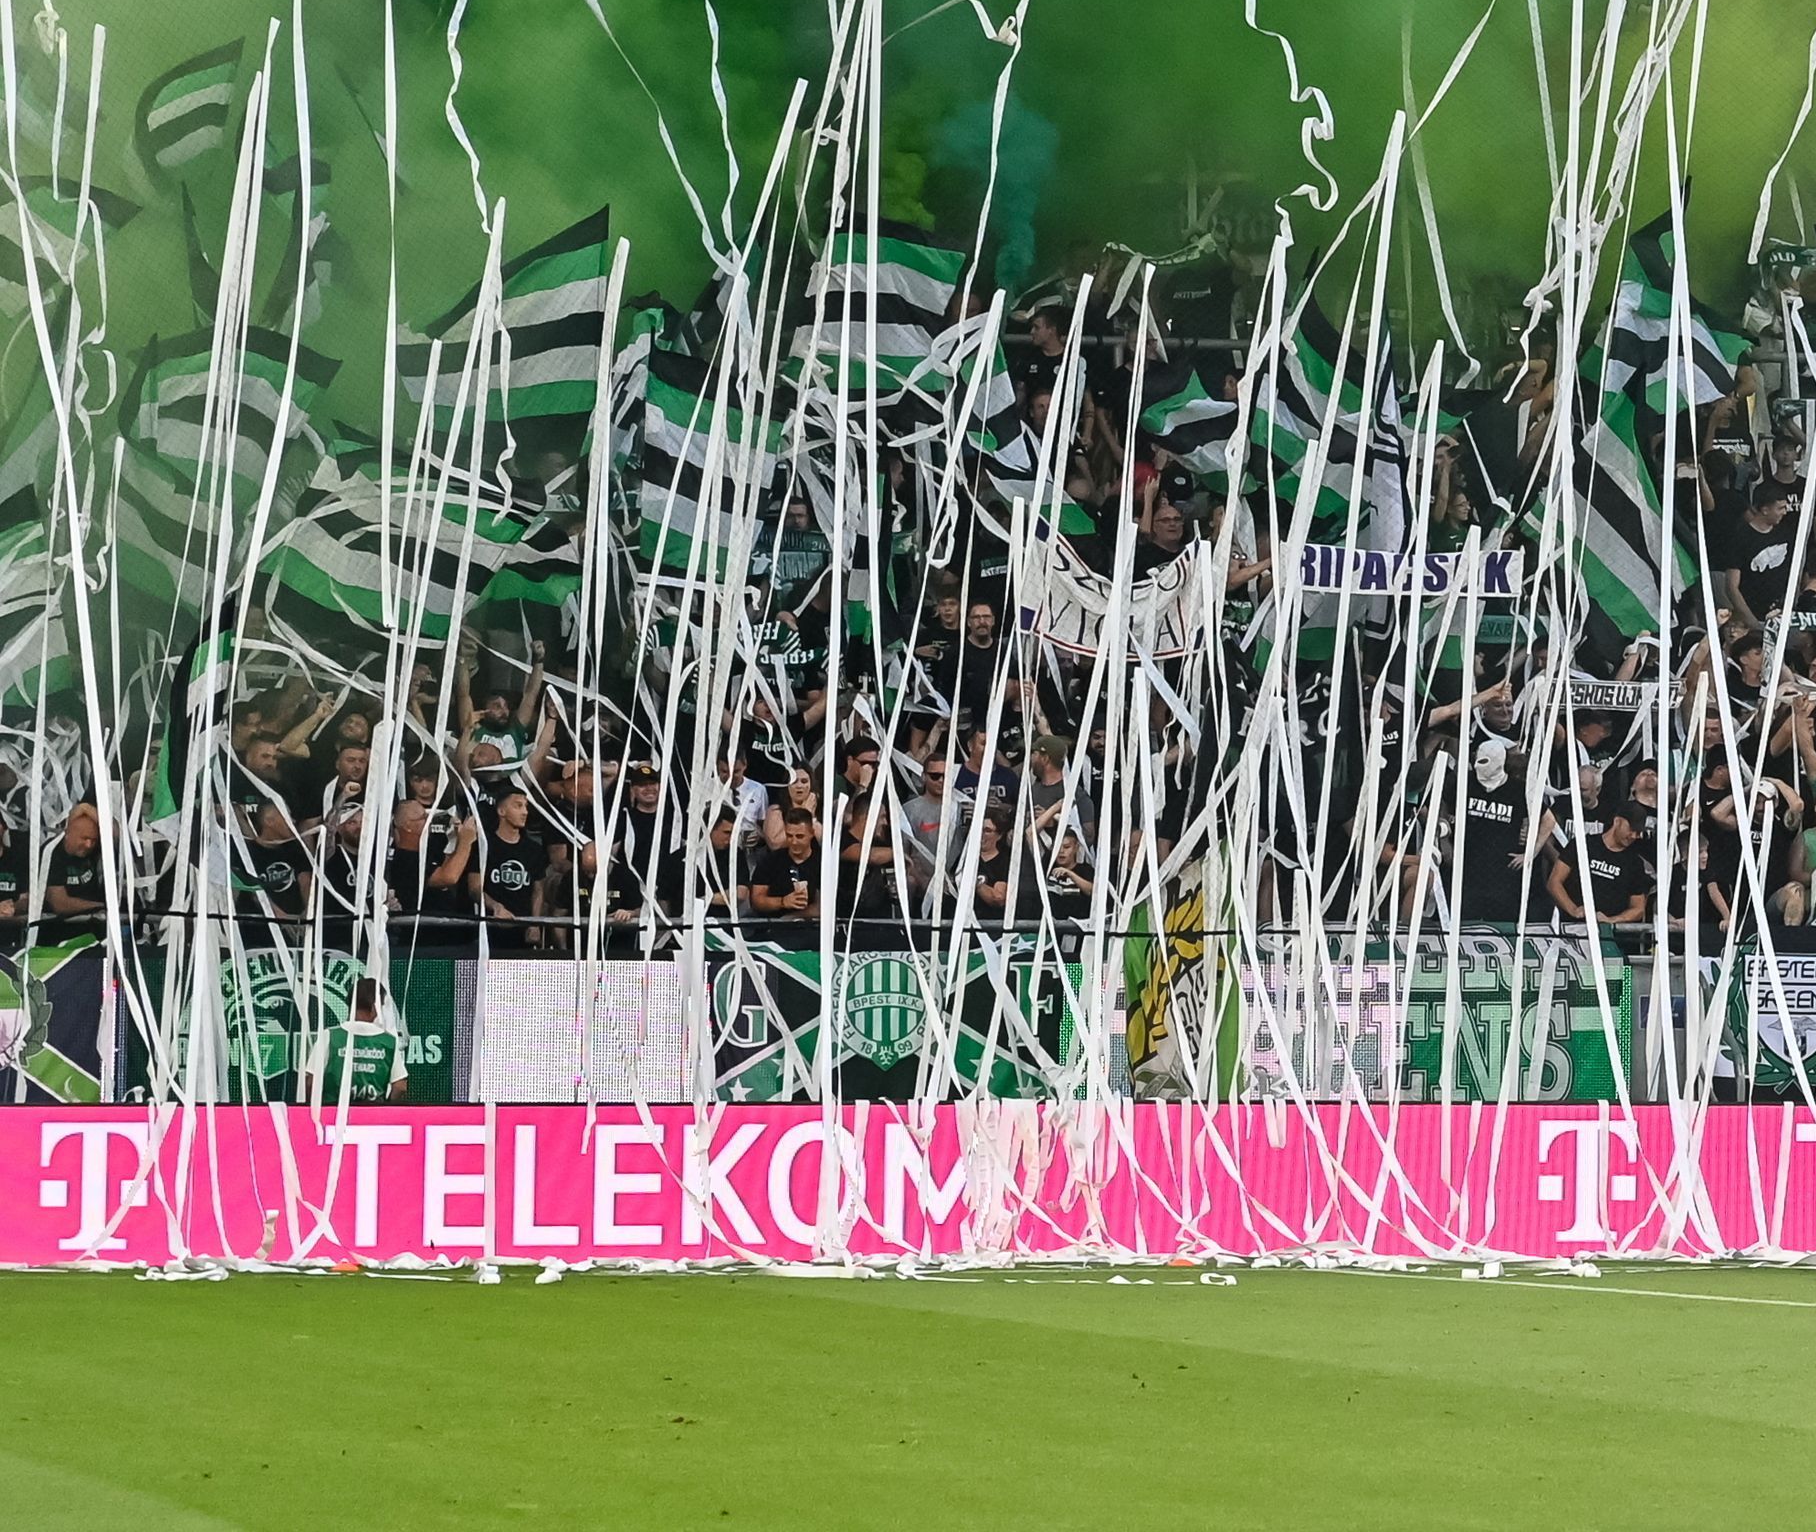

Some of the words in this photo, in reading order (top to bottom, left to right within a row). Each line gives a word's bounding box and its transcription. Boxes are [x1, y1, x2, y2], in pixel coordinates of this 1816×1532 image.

[1468, 797, 1513, 817] FRADI
[325, 1120, 978, 1250] TELEKOM
[1537, 1119, 1638, 1245] T
